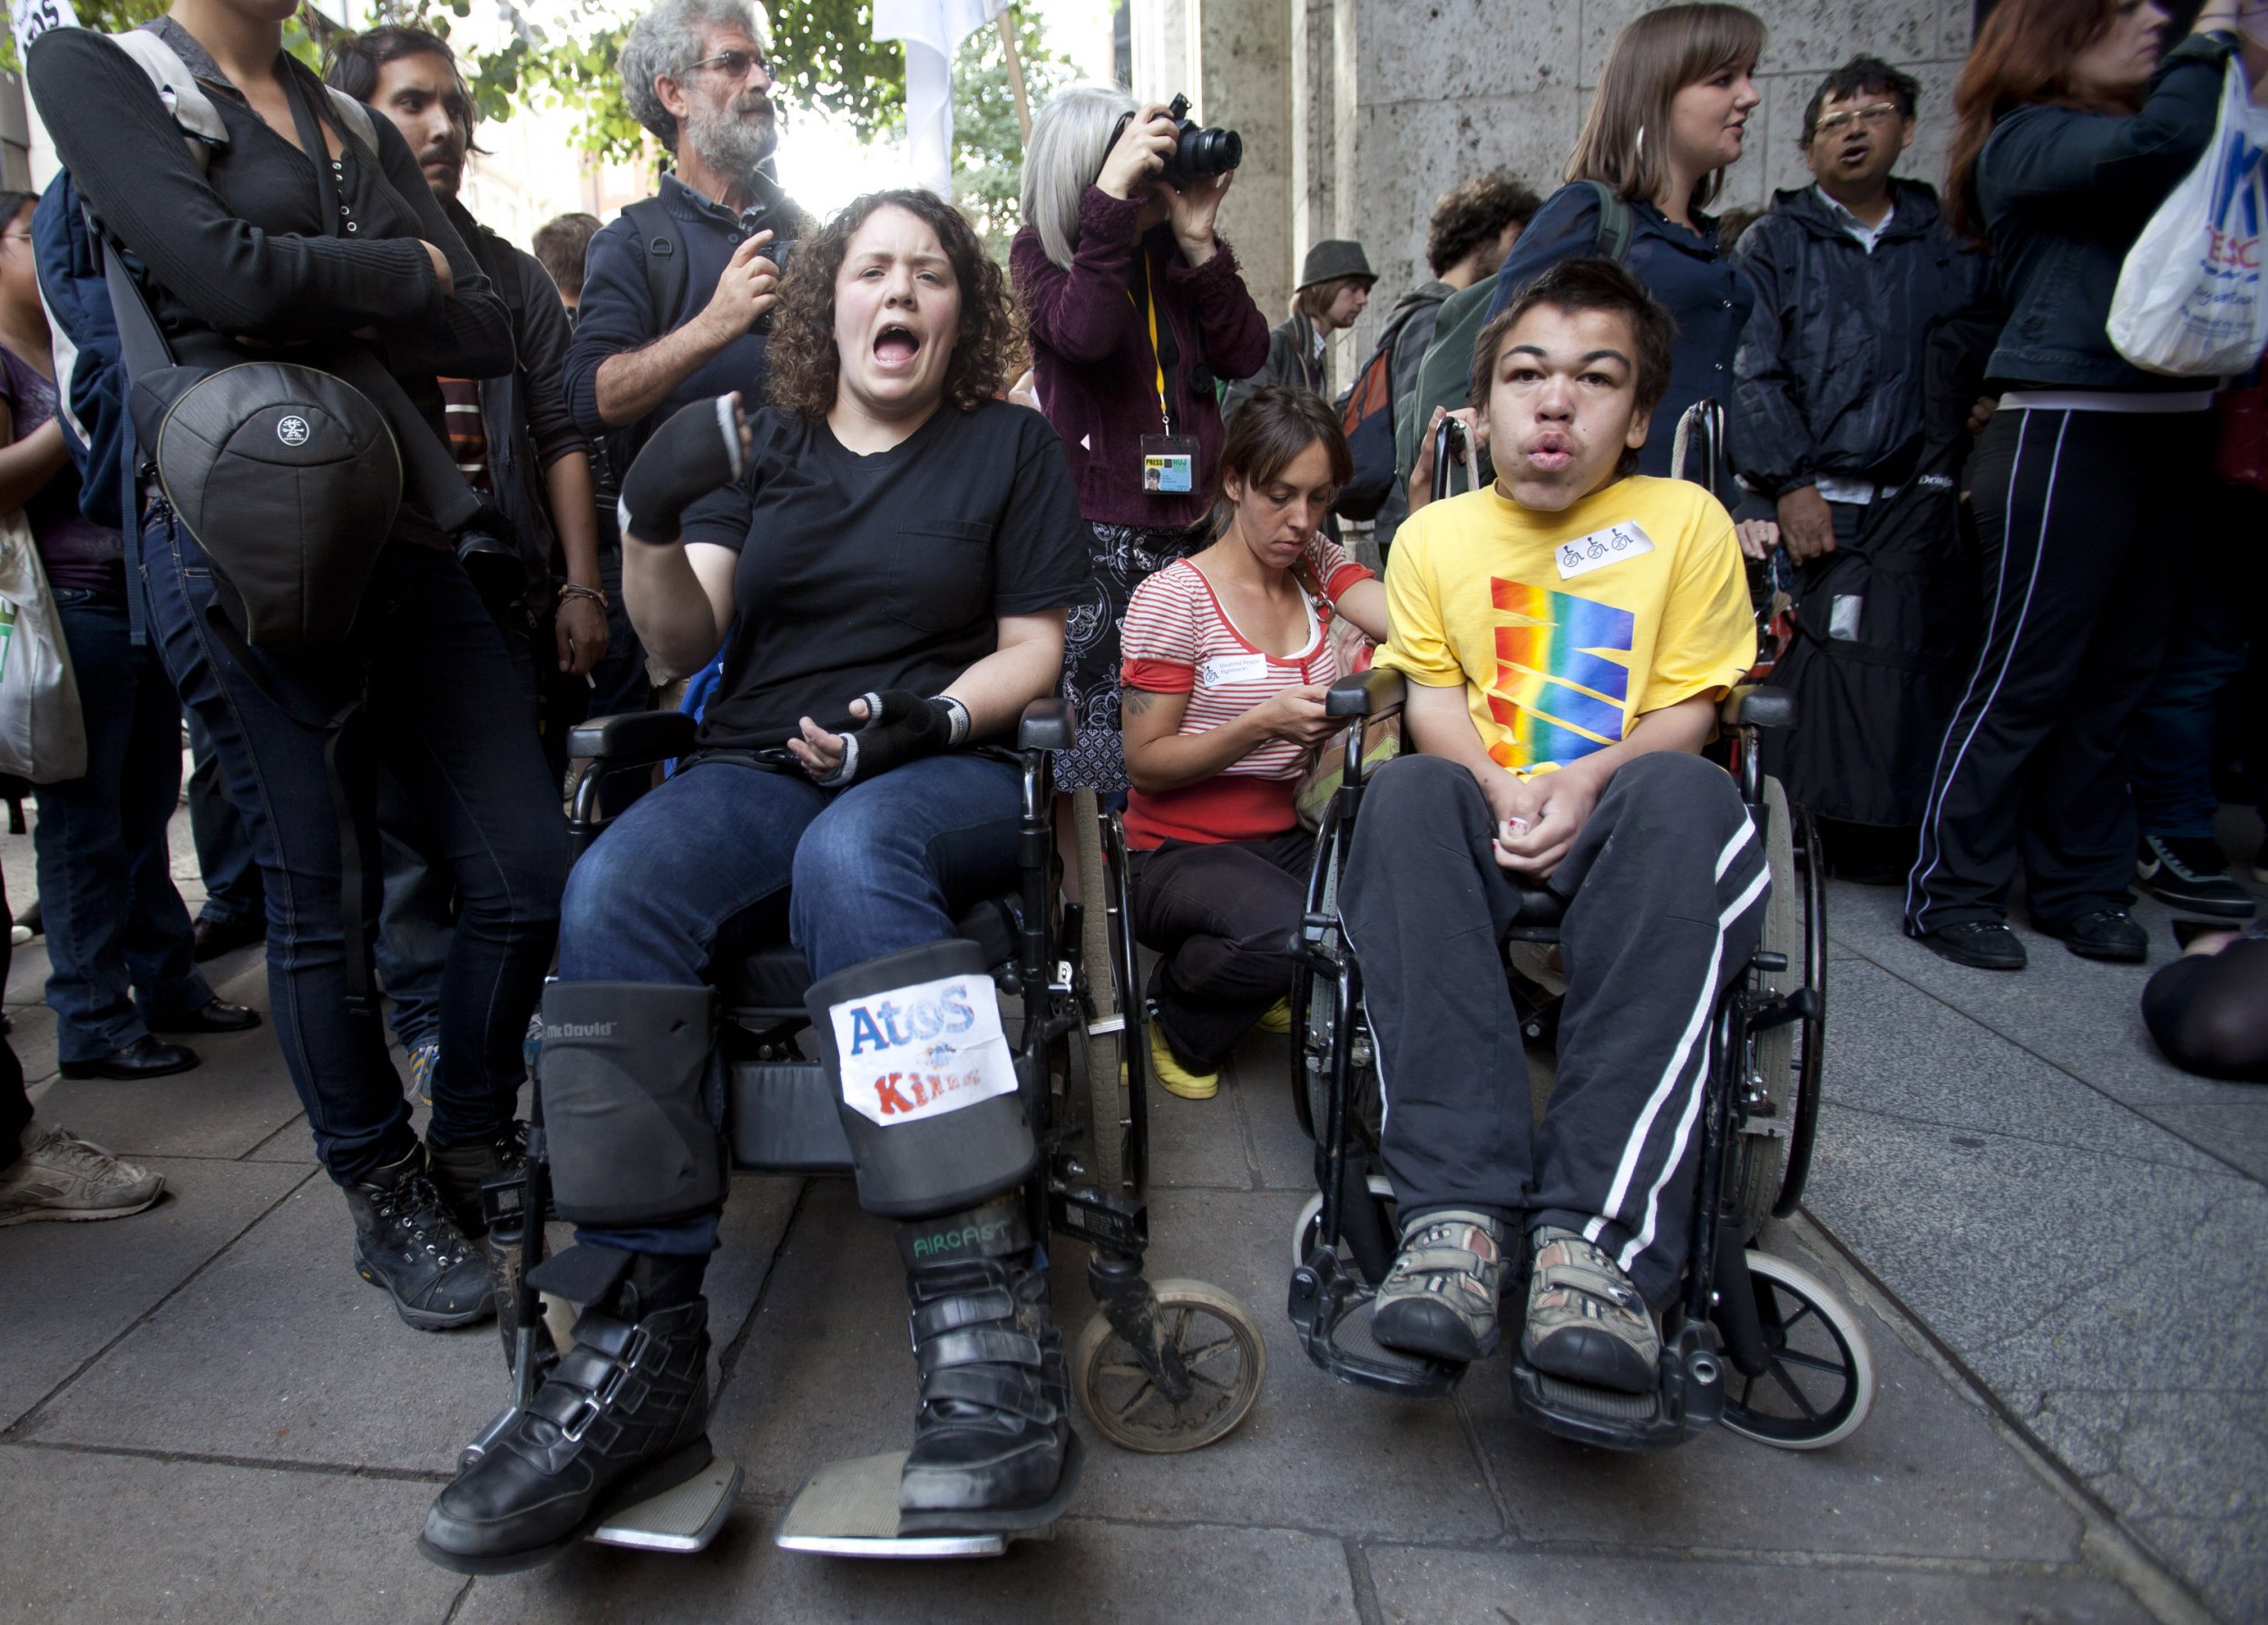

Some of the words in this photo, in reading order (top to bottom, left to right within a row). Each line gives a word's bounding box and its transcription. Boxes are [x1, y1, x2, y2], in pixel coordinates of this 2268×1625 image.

[1146, 458, 1163, 466] PRESS
[546, 1022, 612, 1039] McDavid
[913, 1219, 1013, 1258] AIRCAST
